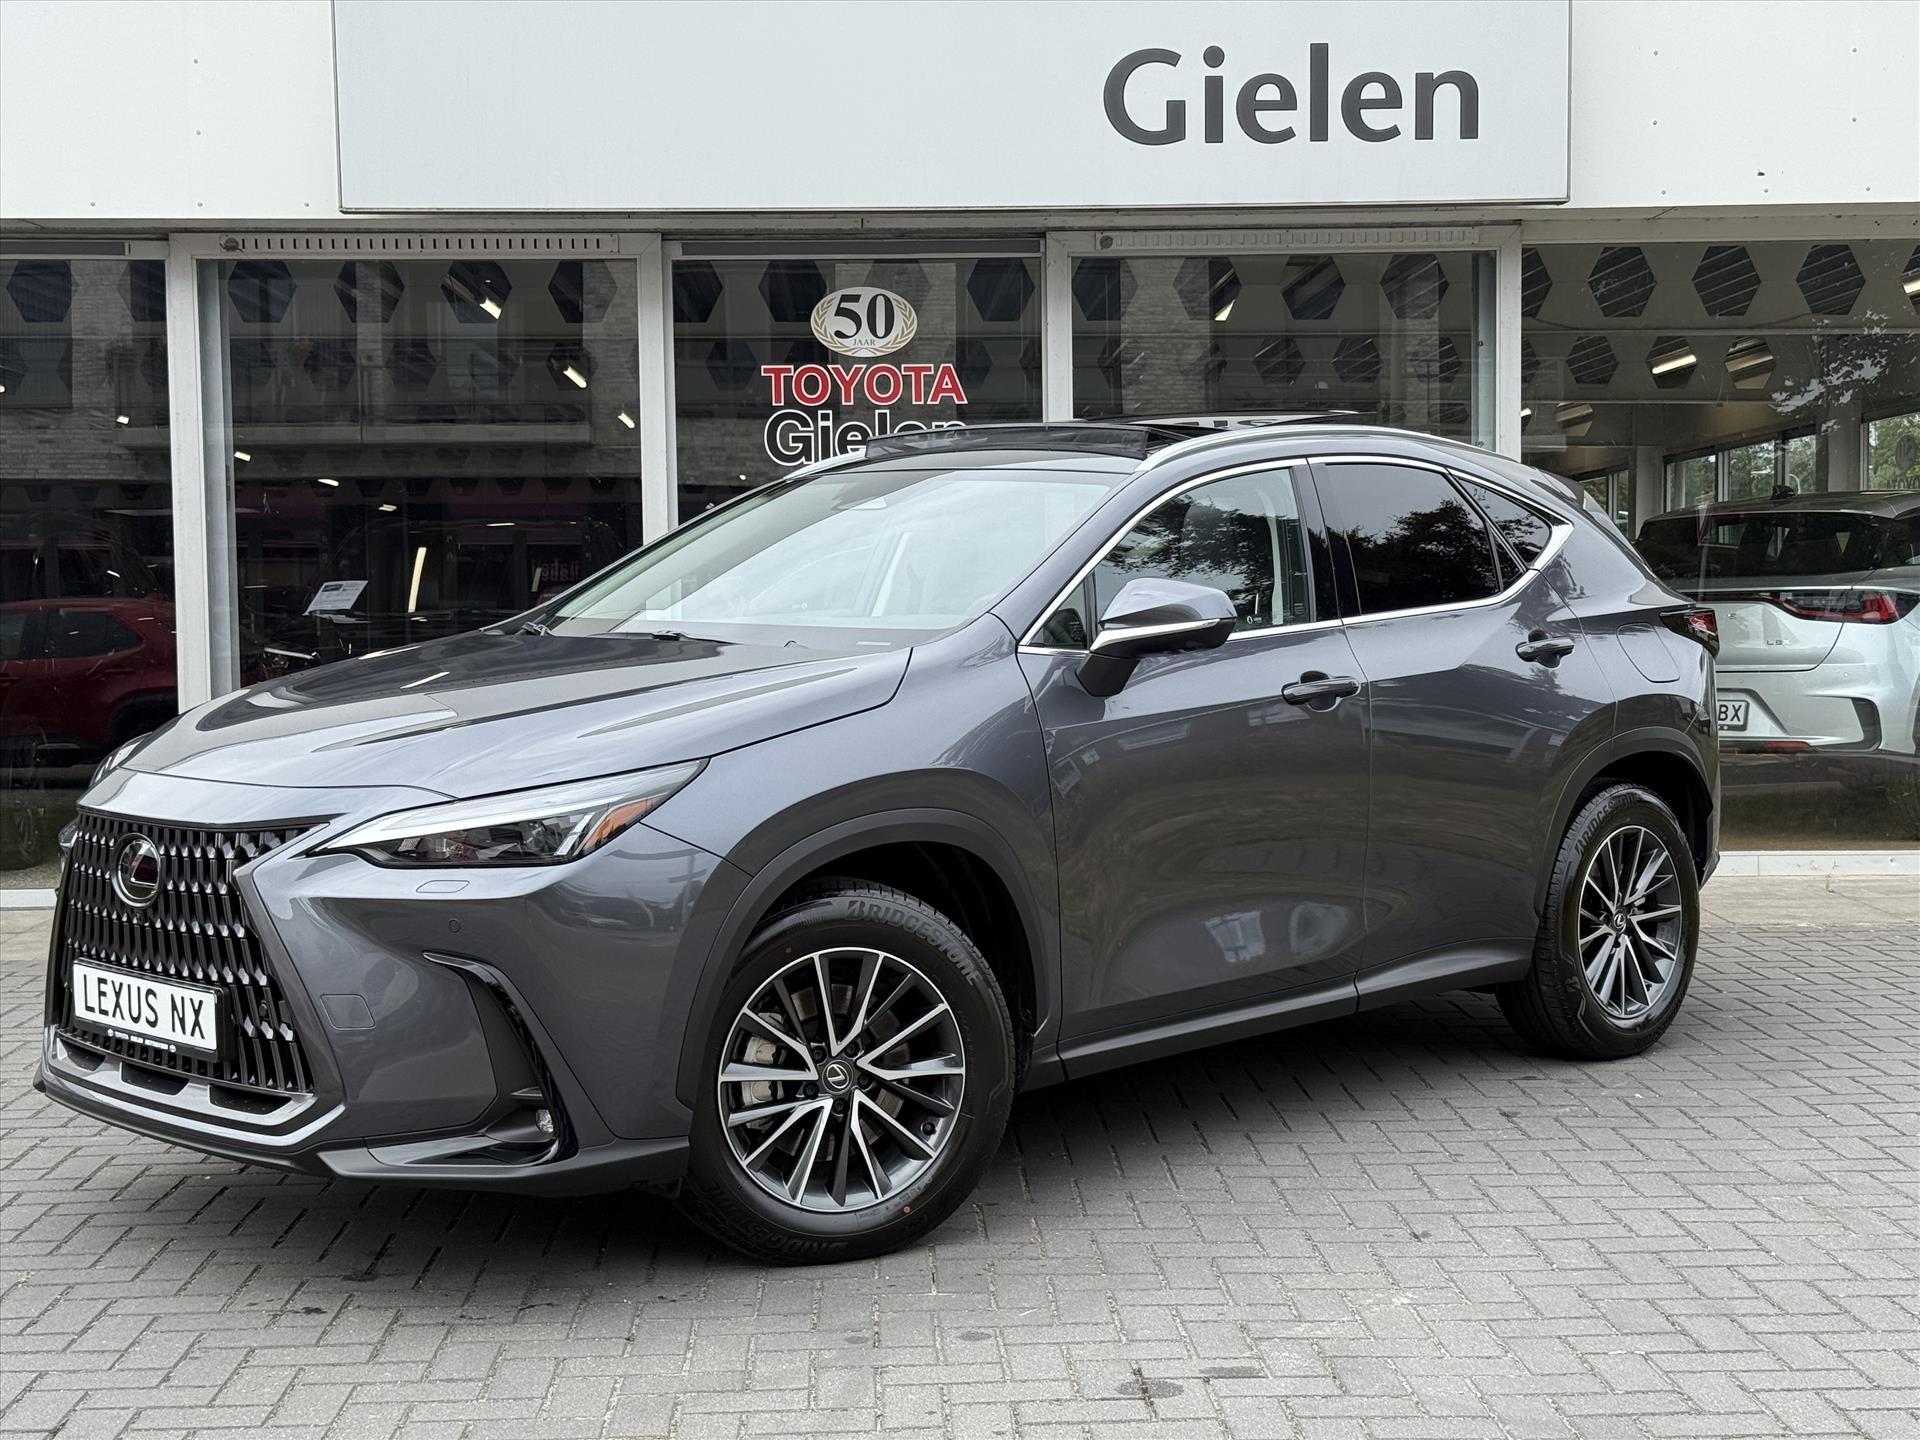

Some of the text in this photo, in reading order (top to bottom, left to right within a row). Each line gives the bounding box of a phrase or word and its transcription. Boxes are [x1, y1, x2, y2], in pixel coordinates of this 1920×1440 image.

[1103, 43, 1479, 146] Gielen
[833, 293, 895, 339] 50
[853, 338, 876, 347] JAAR
[761, 364, 968, 406] TOYOTA
[764, 409, 968, 467] Gie
[846, 900, 980, 986] BRIDGESTONE
[83, 974, 205, 1040] LEXUS NX
